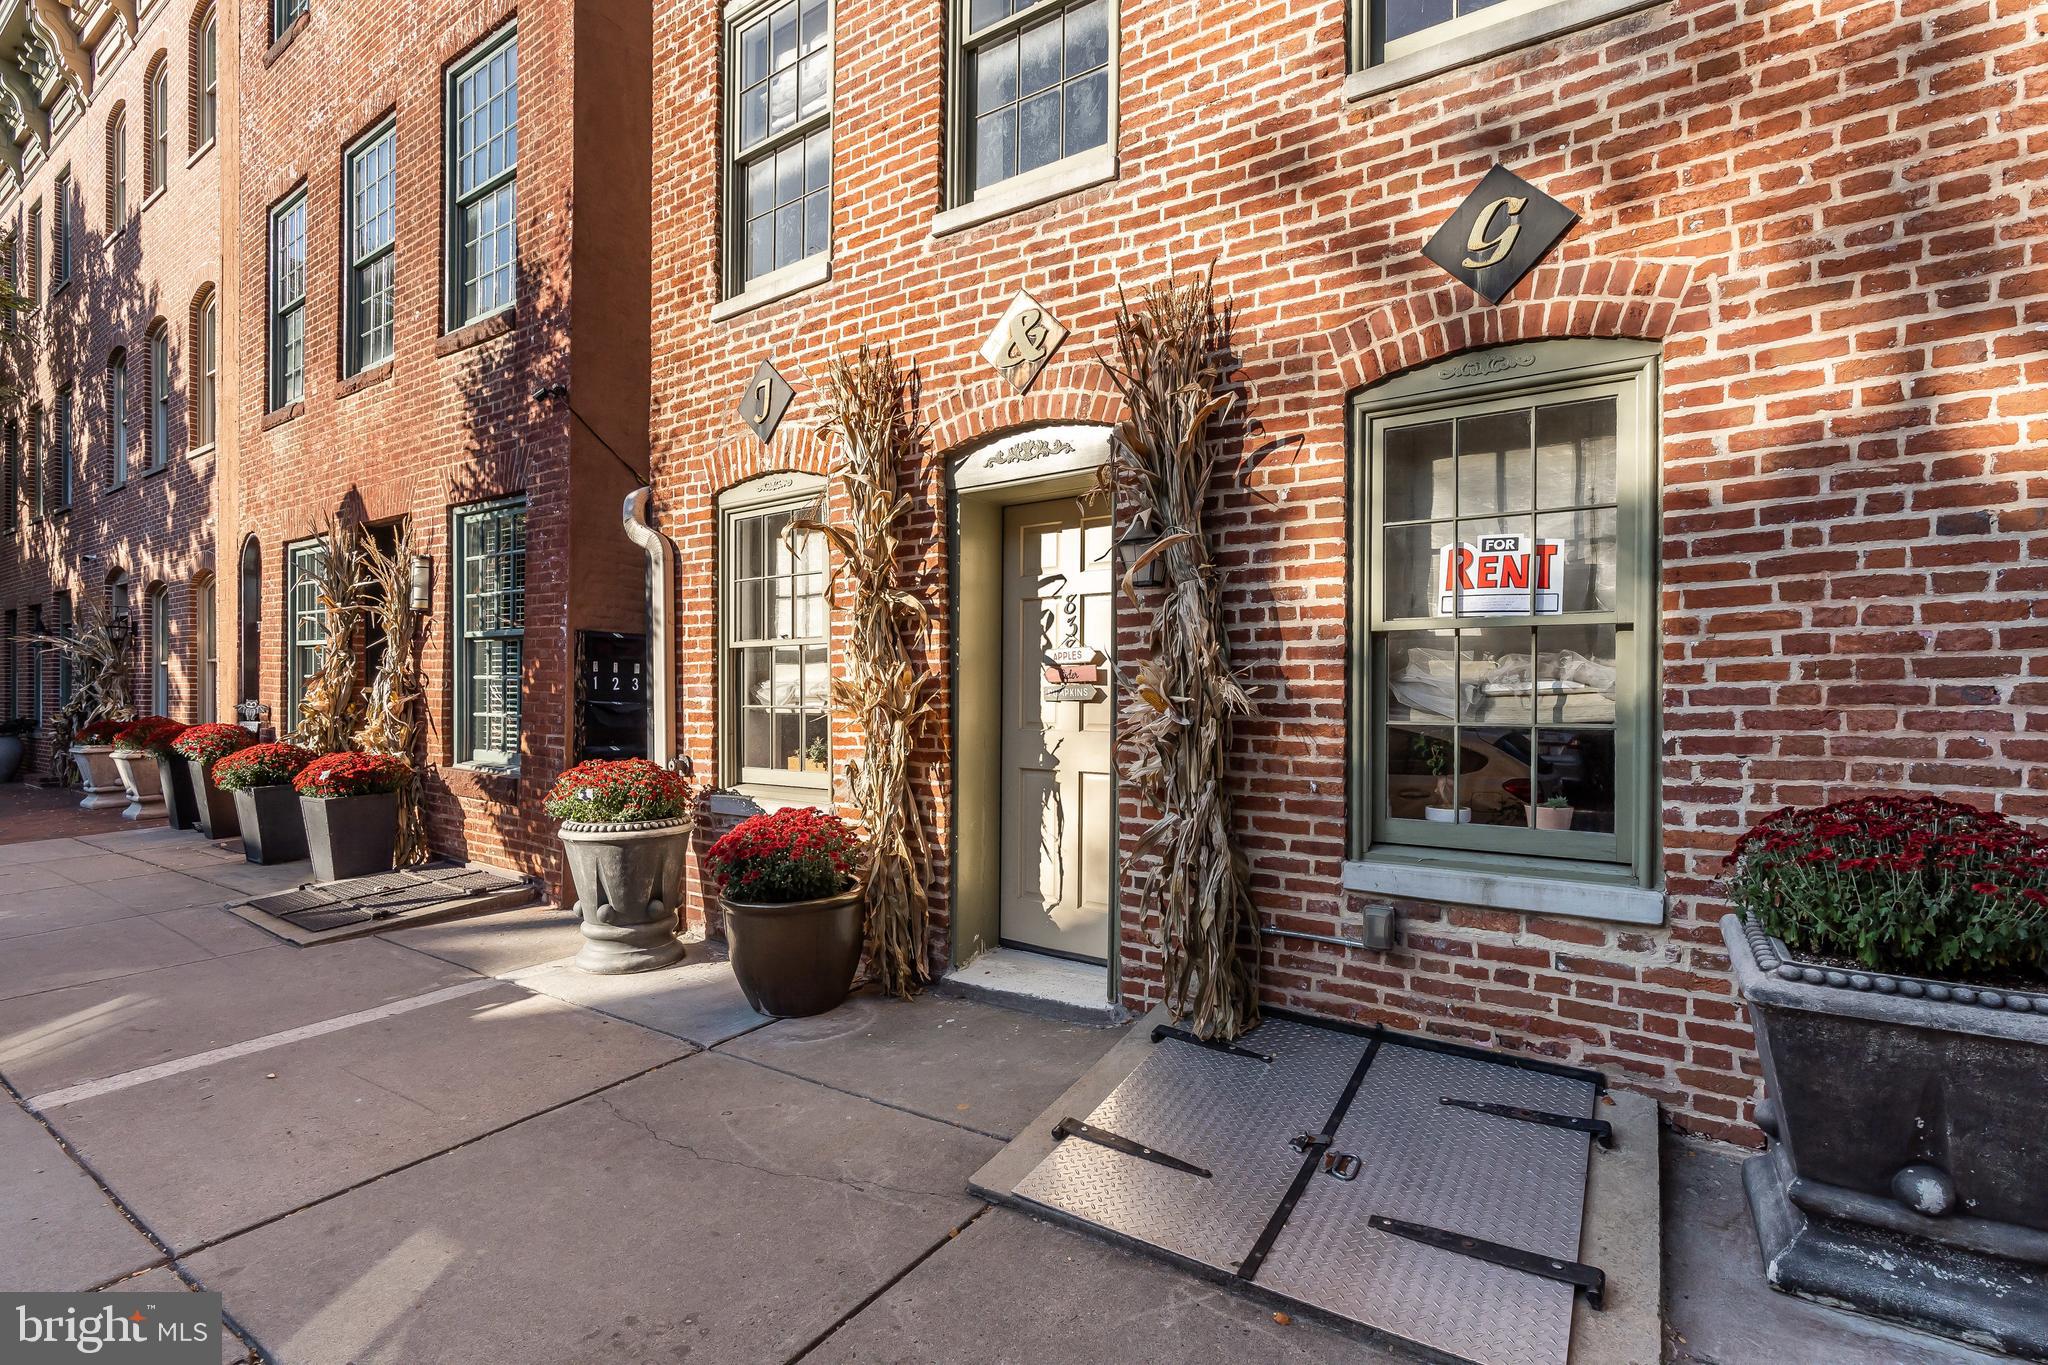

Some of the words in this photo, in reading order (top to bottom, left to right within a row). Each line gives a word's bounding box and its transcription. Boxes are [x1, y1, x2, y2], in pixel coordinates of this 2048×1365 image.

[996, 308, 1049, 368] &
[1462, 197, 1528, 269] G
[1485, 539, 1516, 551] FOR
[1445, 544, 1558, 591] RENT
[1053, 650, 1082, 661] APPLES
[593, 676, 598, 690] 1
[612, 677, 620, 691] 2
[632, 677, 639, 691] 3
